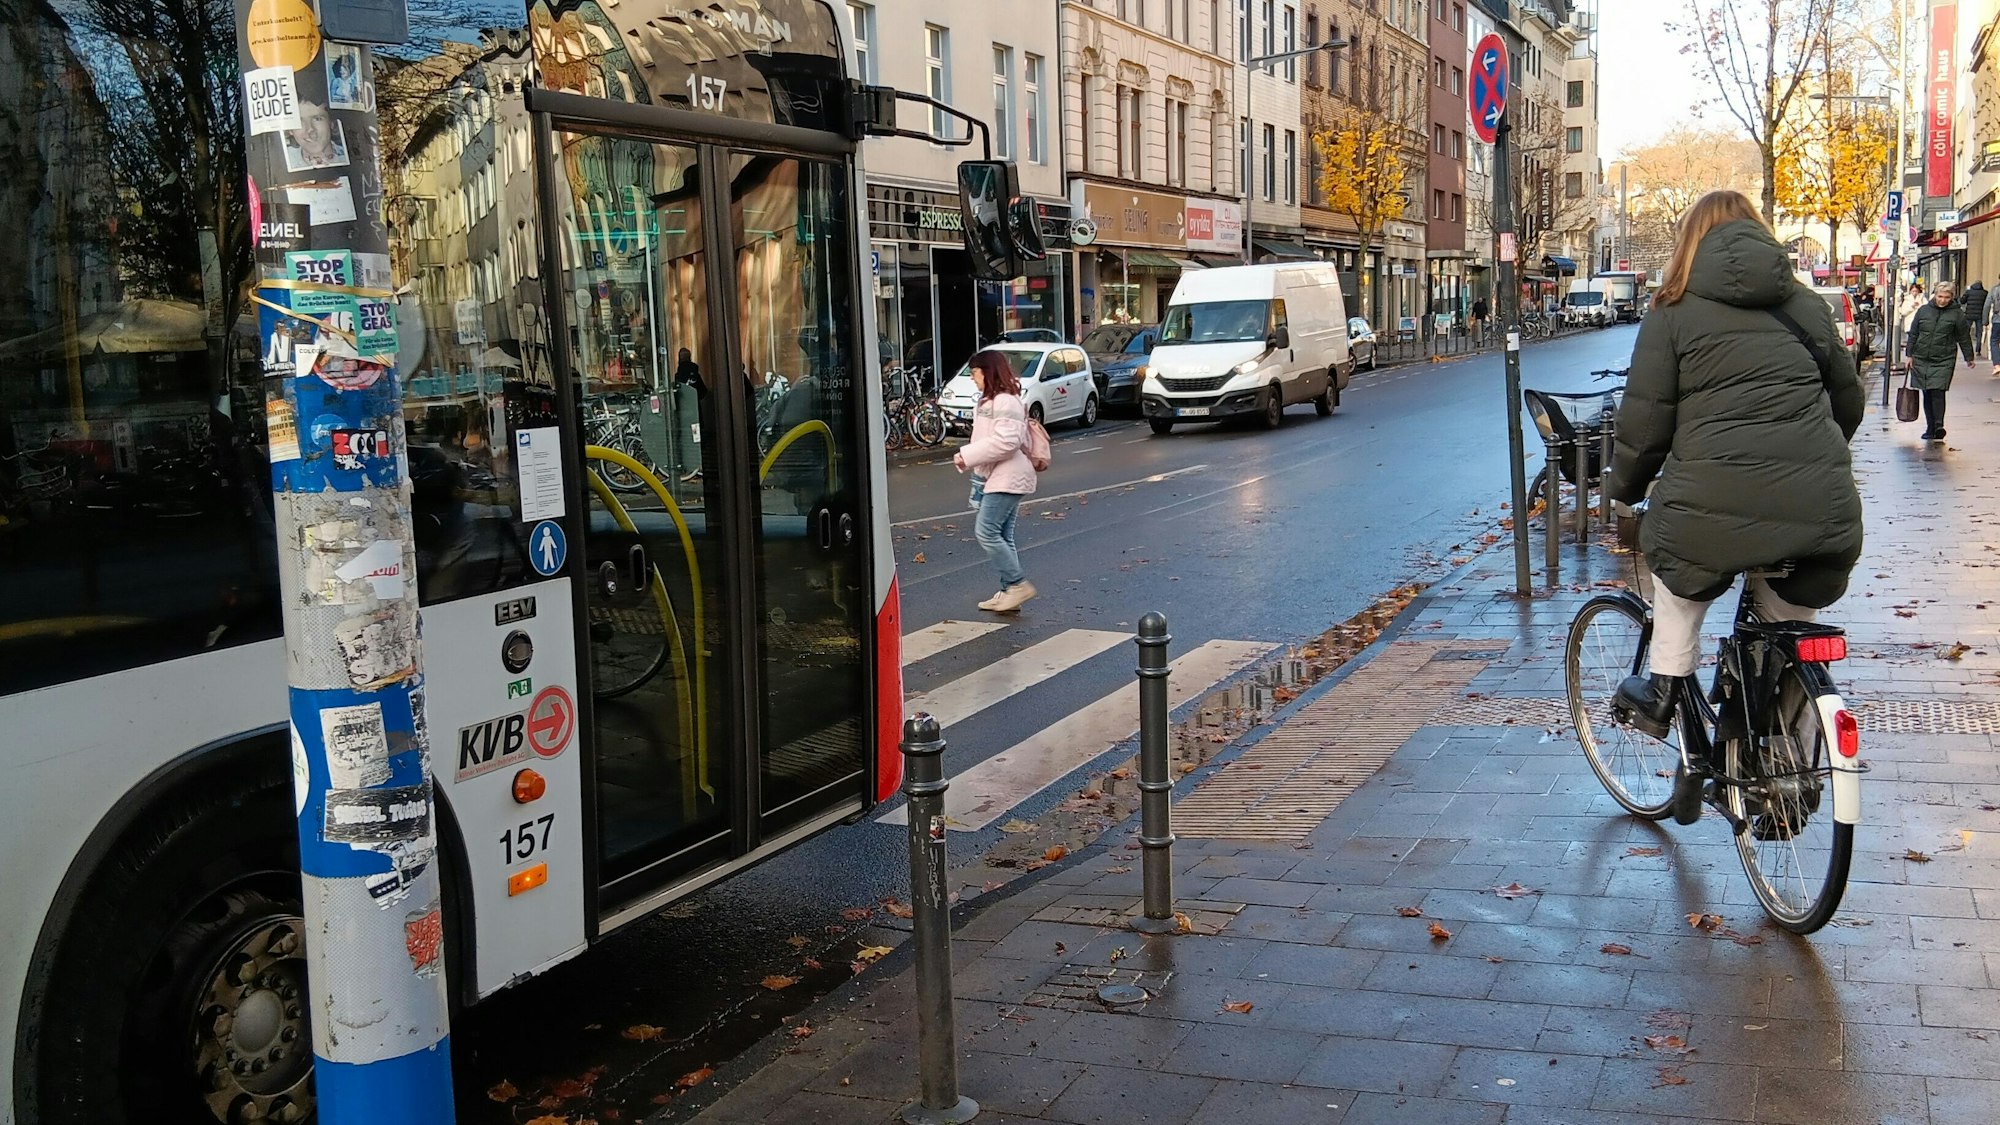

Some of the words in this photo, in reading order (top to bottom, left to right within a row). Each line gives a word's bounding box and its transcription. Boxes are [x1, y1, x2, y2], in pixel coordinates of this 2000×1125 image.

[665, 5, 697, 20] Lion's
[701, 13, 725, 29] City
[729, 9, 792, 43] MAN
[1935, 50, 1949, 82] haus
[250, 77, 290, 101] GUDE
[686, 73, 727, 112] 157
[252, 98, 293, 121] LEUDE
[1936, 88, 1948, 126] comic
[1934, 130, 1946, 157] cöln
[1889, 193, 1899, 218] P
[1938, 213, 1955, 221] alex
[296, 259, 344, 275] STOP
[359, 302, 391, 317] STOP
[361, 316, 392, 331] GEAS
[497, 599, 534, 621] EEV
[459, 714, 525, 770] KVB
[500, 812, 555, 865] 157
